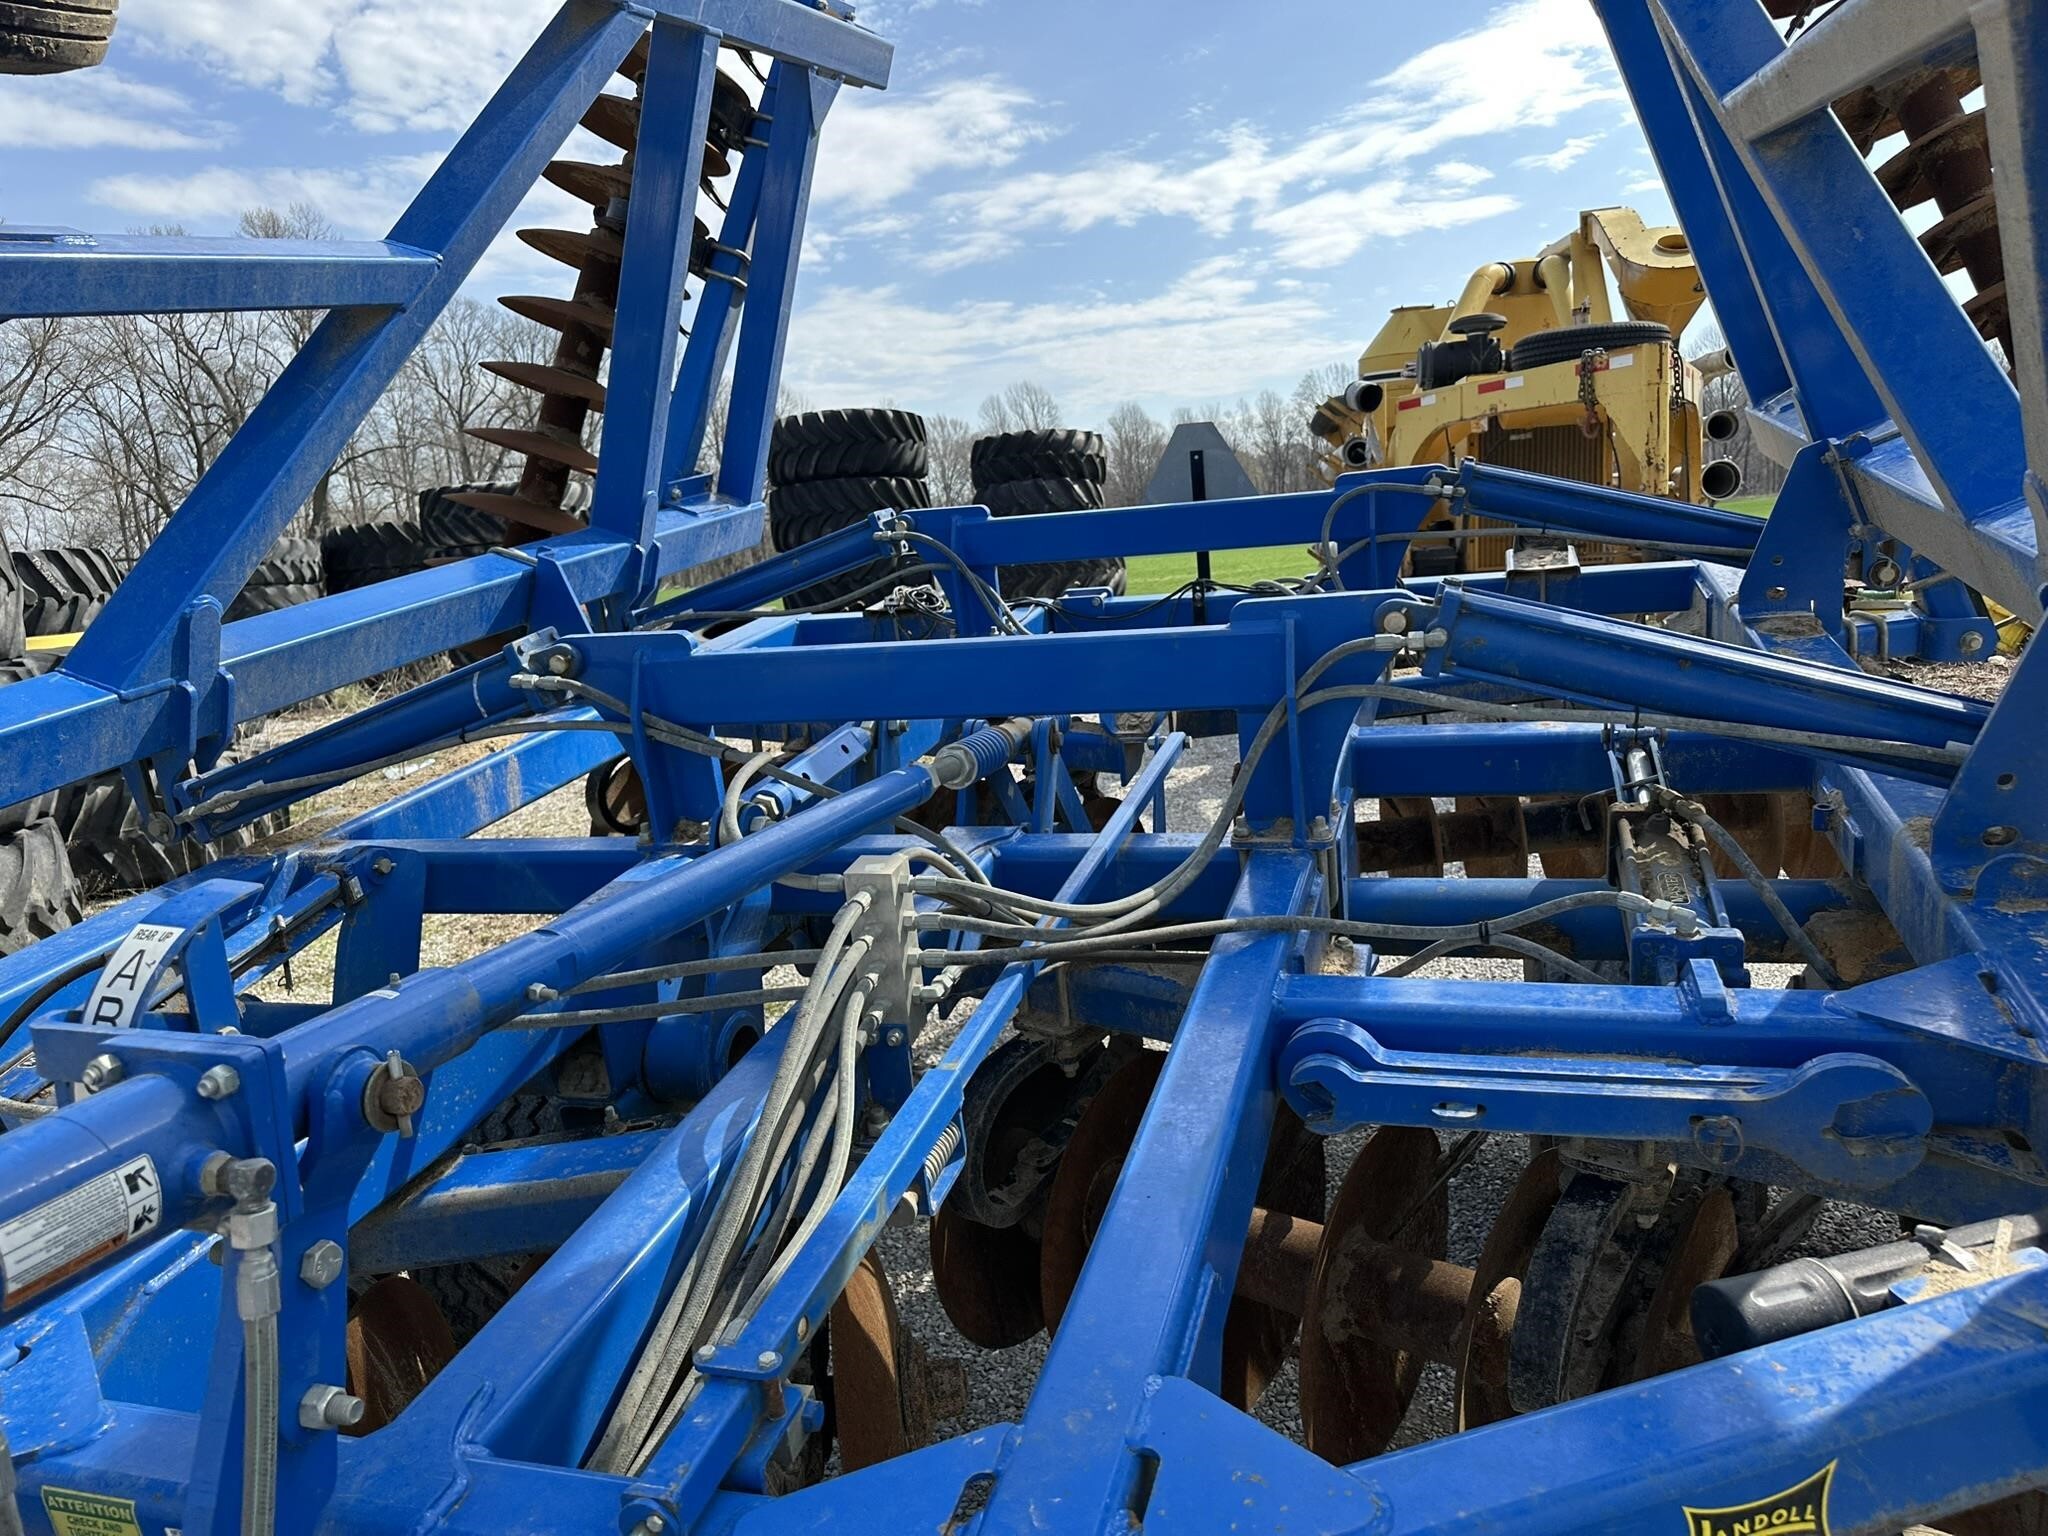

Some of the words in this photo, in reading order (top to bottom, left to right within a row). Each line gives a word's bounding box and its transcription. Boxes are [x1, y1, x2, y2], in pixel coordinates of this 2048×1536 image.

[133, 928, 158, 942] REAR
[158, 930, 174, 942] UP
[107, 949, 146, 991] A
[48, 1496, 131, 1521] ATTENTION
[66, 1515, 101, 1530] CHECK
